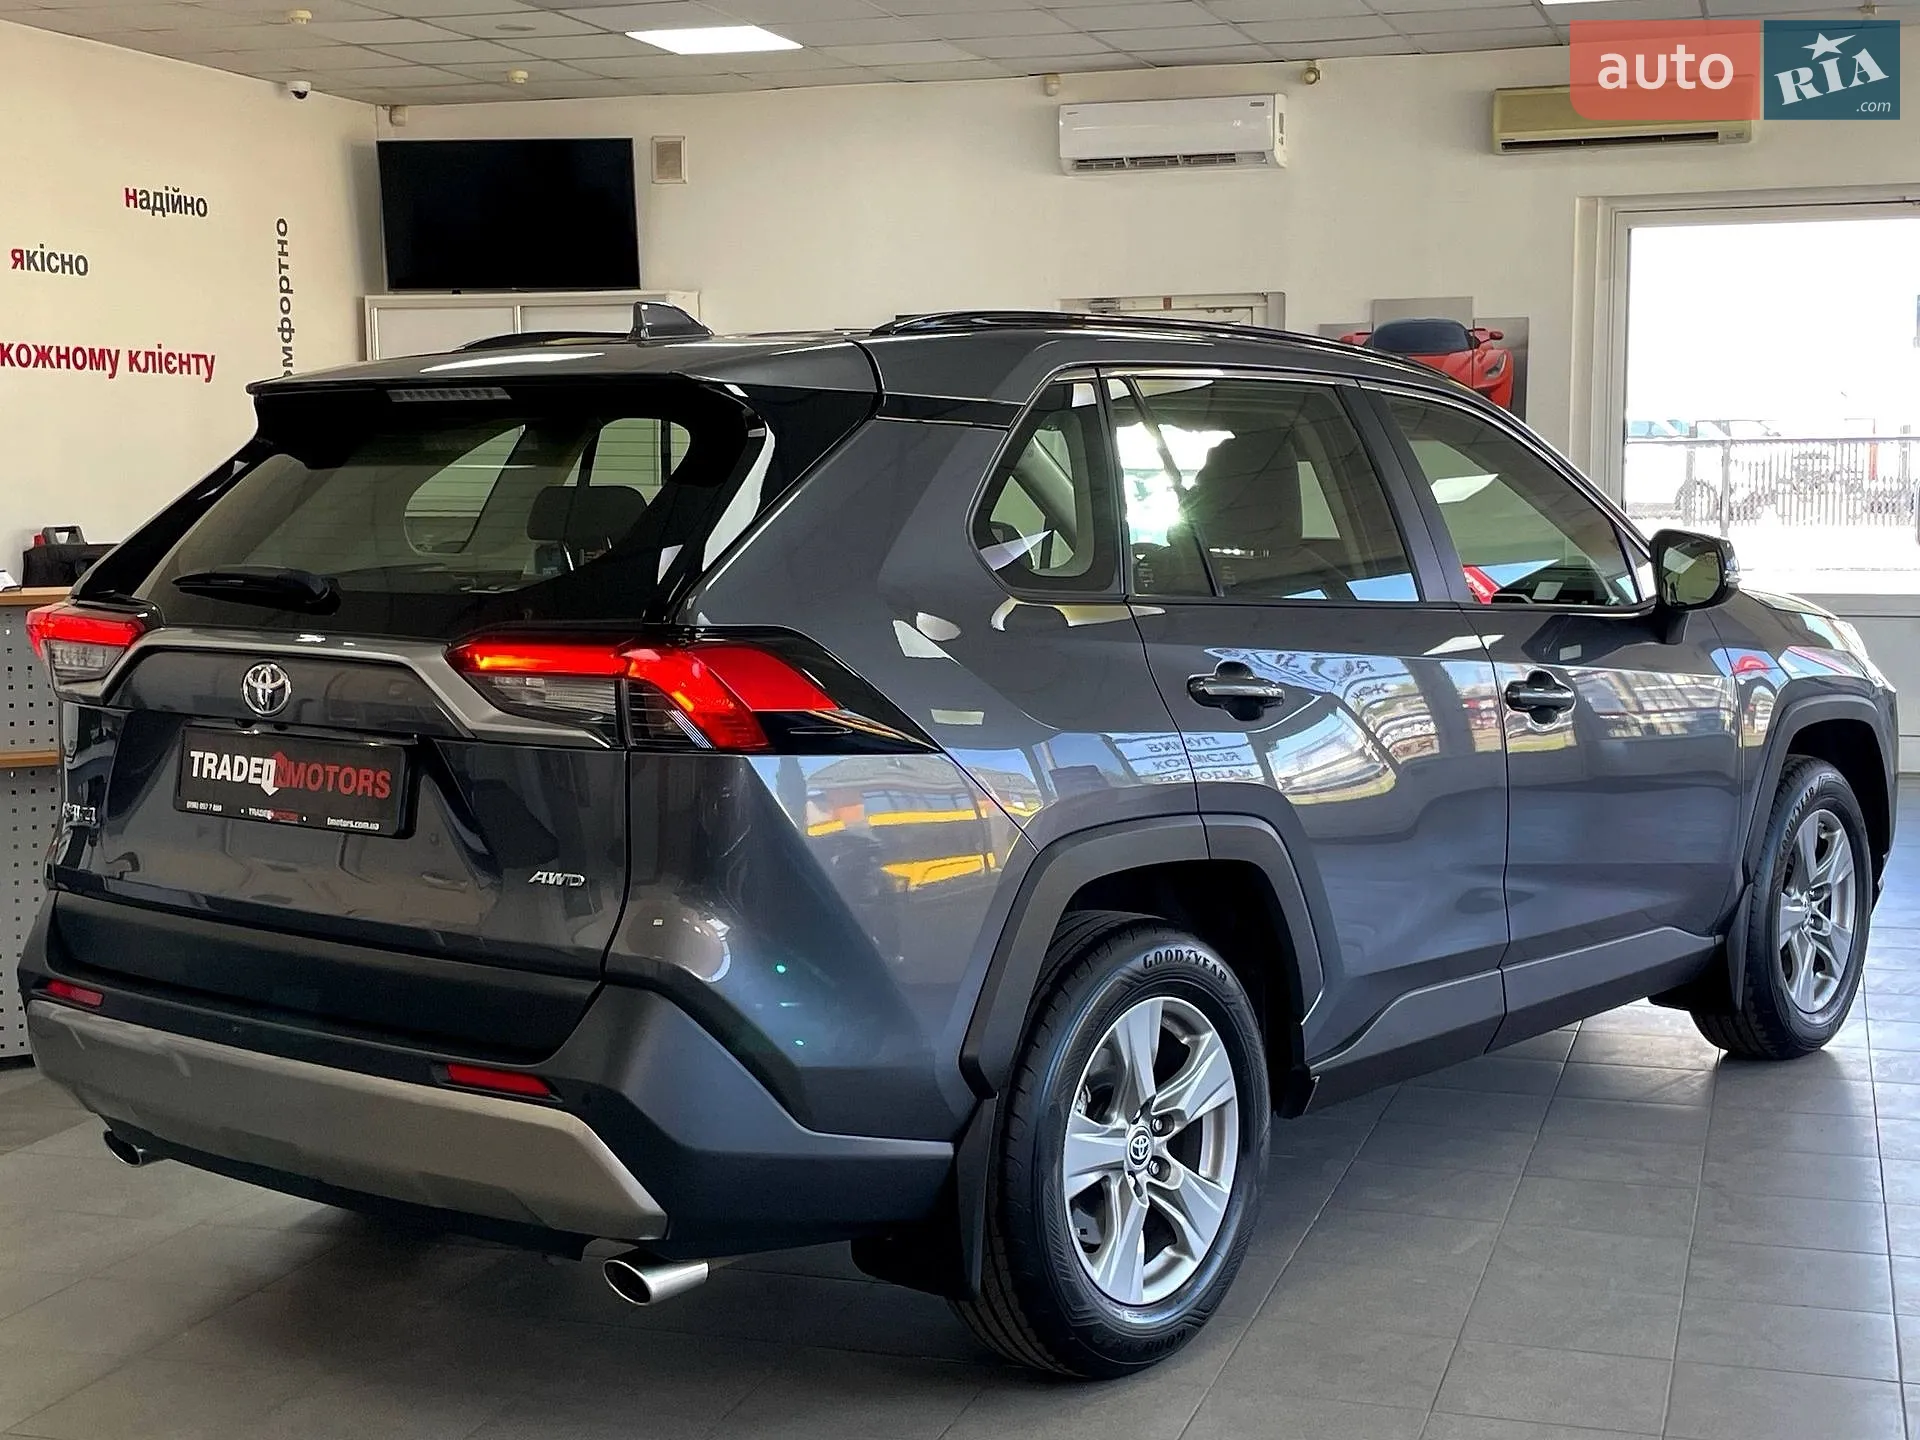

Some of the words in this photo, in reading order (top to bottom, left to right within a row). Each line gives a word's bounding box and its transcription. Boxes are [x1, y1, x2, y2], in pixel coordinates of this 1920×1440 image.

[124, 186, 209, 219] надійно
[11, 243, 90, 277] якісно
[0, 342, 121, 380] кожному
[127, 343, 216, 384] клієнту
[190, 750, 264, 785] TRADE
[288, 758, 392, 800] MOTORS
[527, 870, 586, 887] AWD
[1142, 948, 1229, 986] GOODYEAR
